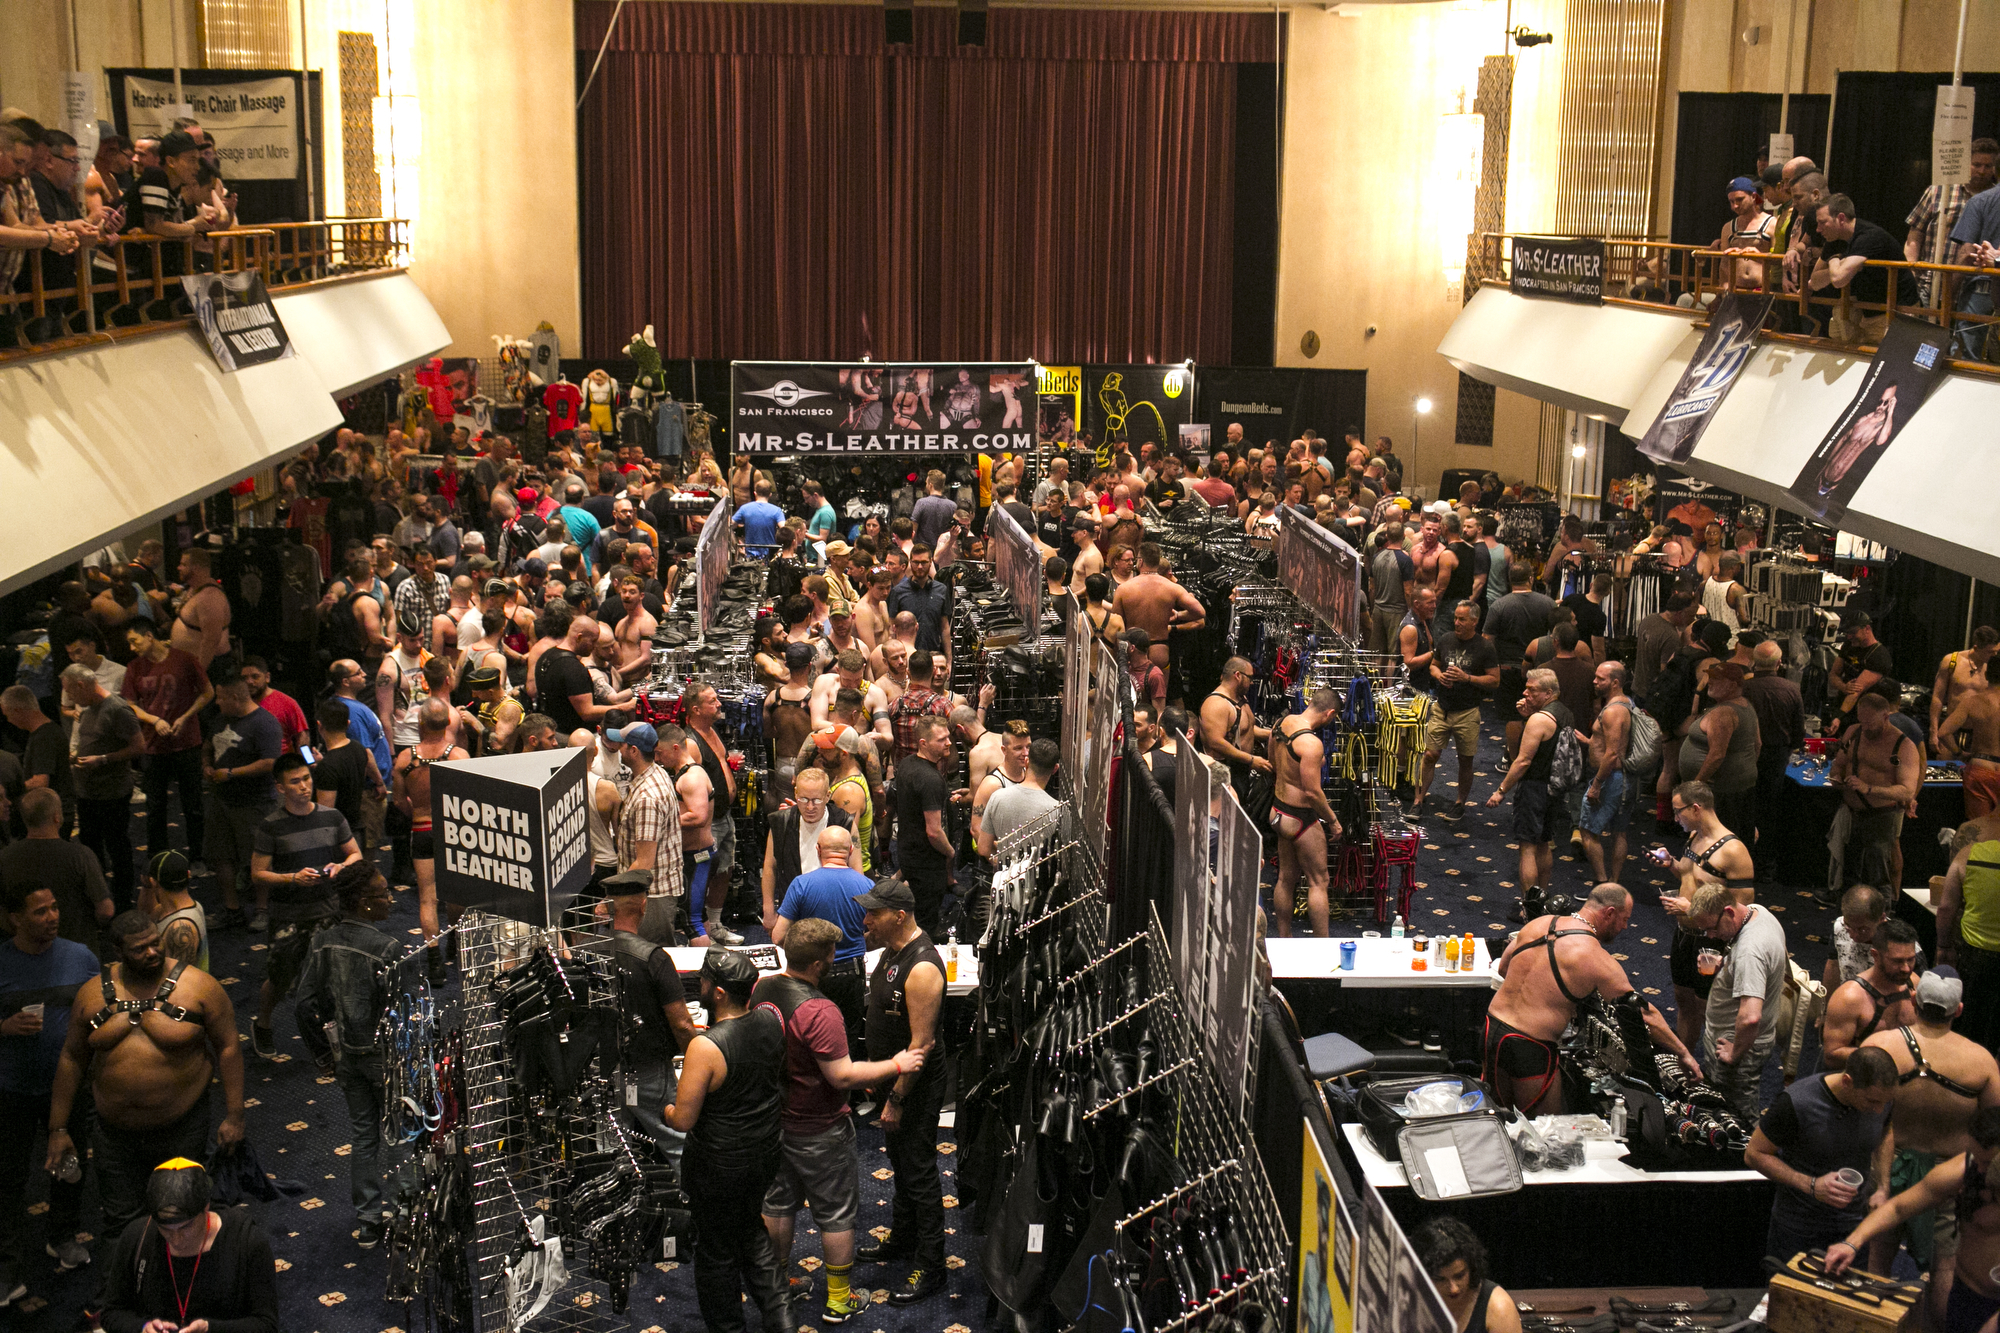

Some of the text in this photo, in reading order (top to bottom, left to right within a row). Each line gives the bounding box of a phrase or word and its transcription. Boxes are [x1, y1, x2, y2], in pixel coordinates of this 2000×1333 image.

[132, 90, 165, 109] Hands
[185, 94, 207, 113] Hire
[209, 94, 238, 114] Chair
[240, 93, 286, 114] Massage
[217, 145, 289, 164] ssage and More
[1555, 279, 1568, 292] SAN
[216, 302, 276, 333] INTERNATIONAL
[241, 326, 281, 352] LEATHER
[738, 407, 833, 416] SAN FRANCISCO
[1220, 401, 1283, 415] DungeonBeds.com
[1667, 397, 1713, 418] LUBRICANTS
[442, 793, 530, 837] NORTH
[547, 777, 584, 835] NORTH
[443, 820, 532, 863] BOUND
[549, 805, 586, 862] BOUND
[445, 847, 535, 893] LEATHER
[551, 831, 587, 889] LEATHER
